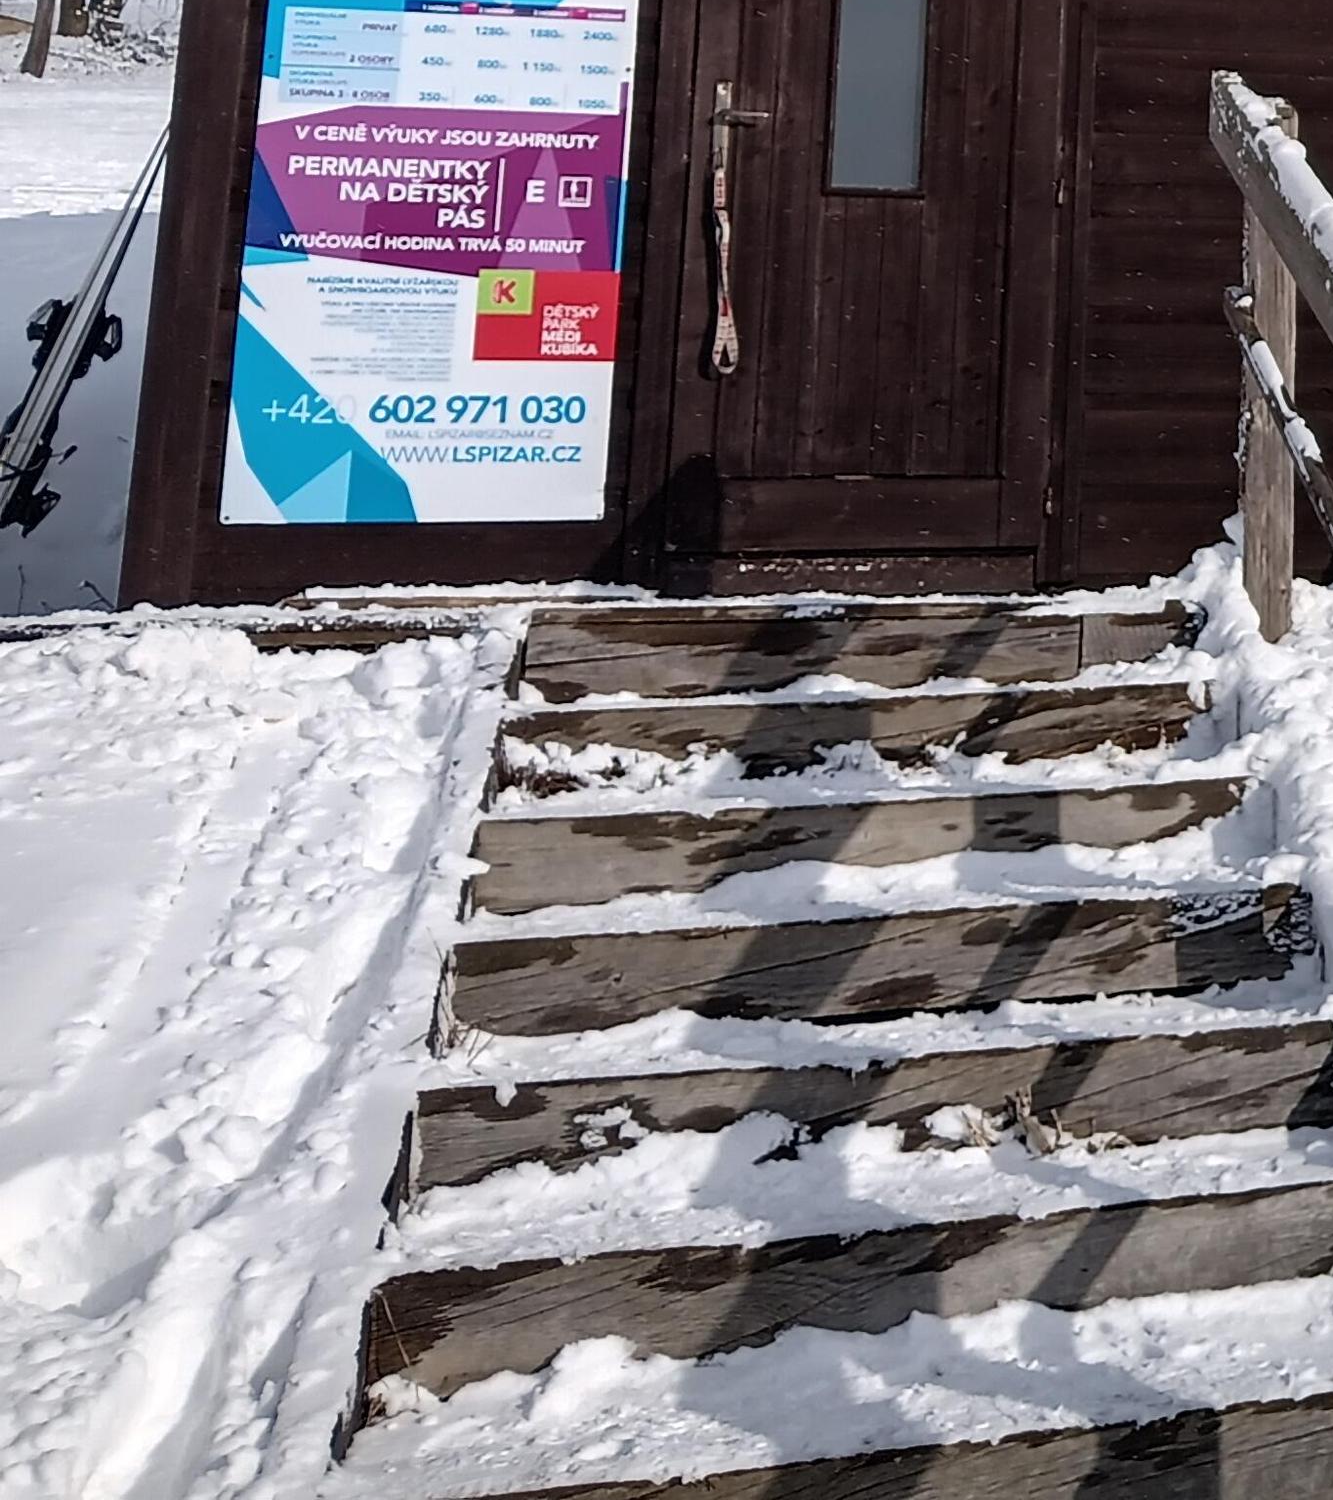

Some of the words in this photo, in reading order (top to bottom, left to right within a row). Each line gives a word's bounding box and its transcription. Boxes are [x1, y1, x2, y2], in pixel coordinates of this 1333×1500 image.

[295, 125, 310, 141] V
[313, 123, 367, 143] CENĚ
[372, 123, 439, 145] VÝUKY
[440, 129, 492, 148] JSOU
[495, 131, 599, 150] ZAHRNUTY
[288, 155, 492, 180] PERMANENTKY
[340, 183, 381, 202] NA
[387, 180, 490, 204] DĚTSKÝ
[526, 181, 546, 203] E
[437, 204, 486, 229] PÁS
[279, 231, 384, 251] VYUČOVACÍ
[384, 236, 454, 252] HODINA
[459, 233, 501, 253] TRVÁ
[505, 238, 526, 253] 50
[528, 238, 586, 254] MINUT
[493, 279, 516, 304] K
[542, 318, 580, 330] PARK
[262, 393, 357, 424] +420
[368, 395, 436, 424] 602
[446, 395, 508, 424] 971
[520, 395, 586, 424] 030
[380, 445, 582, 464] WWW.LSPIZAR.CZ
